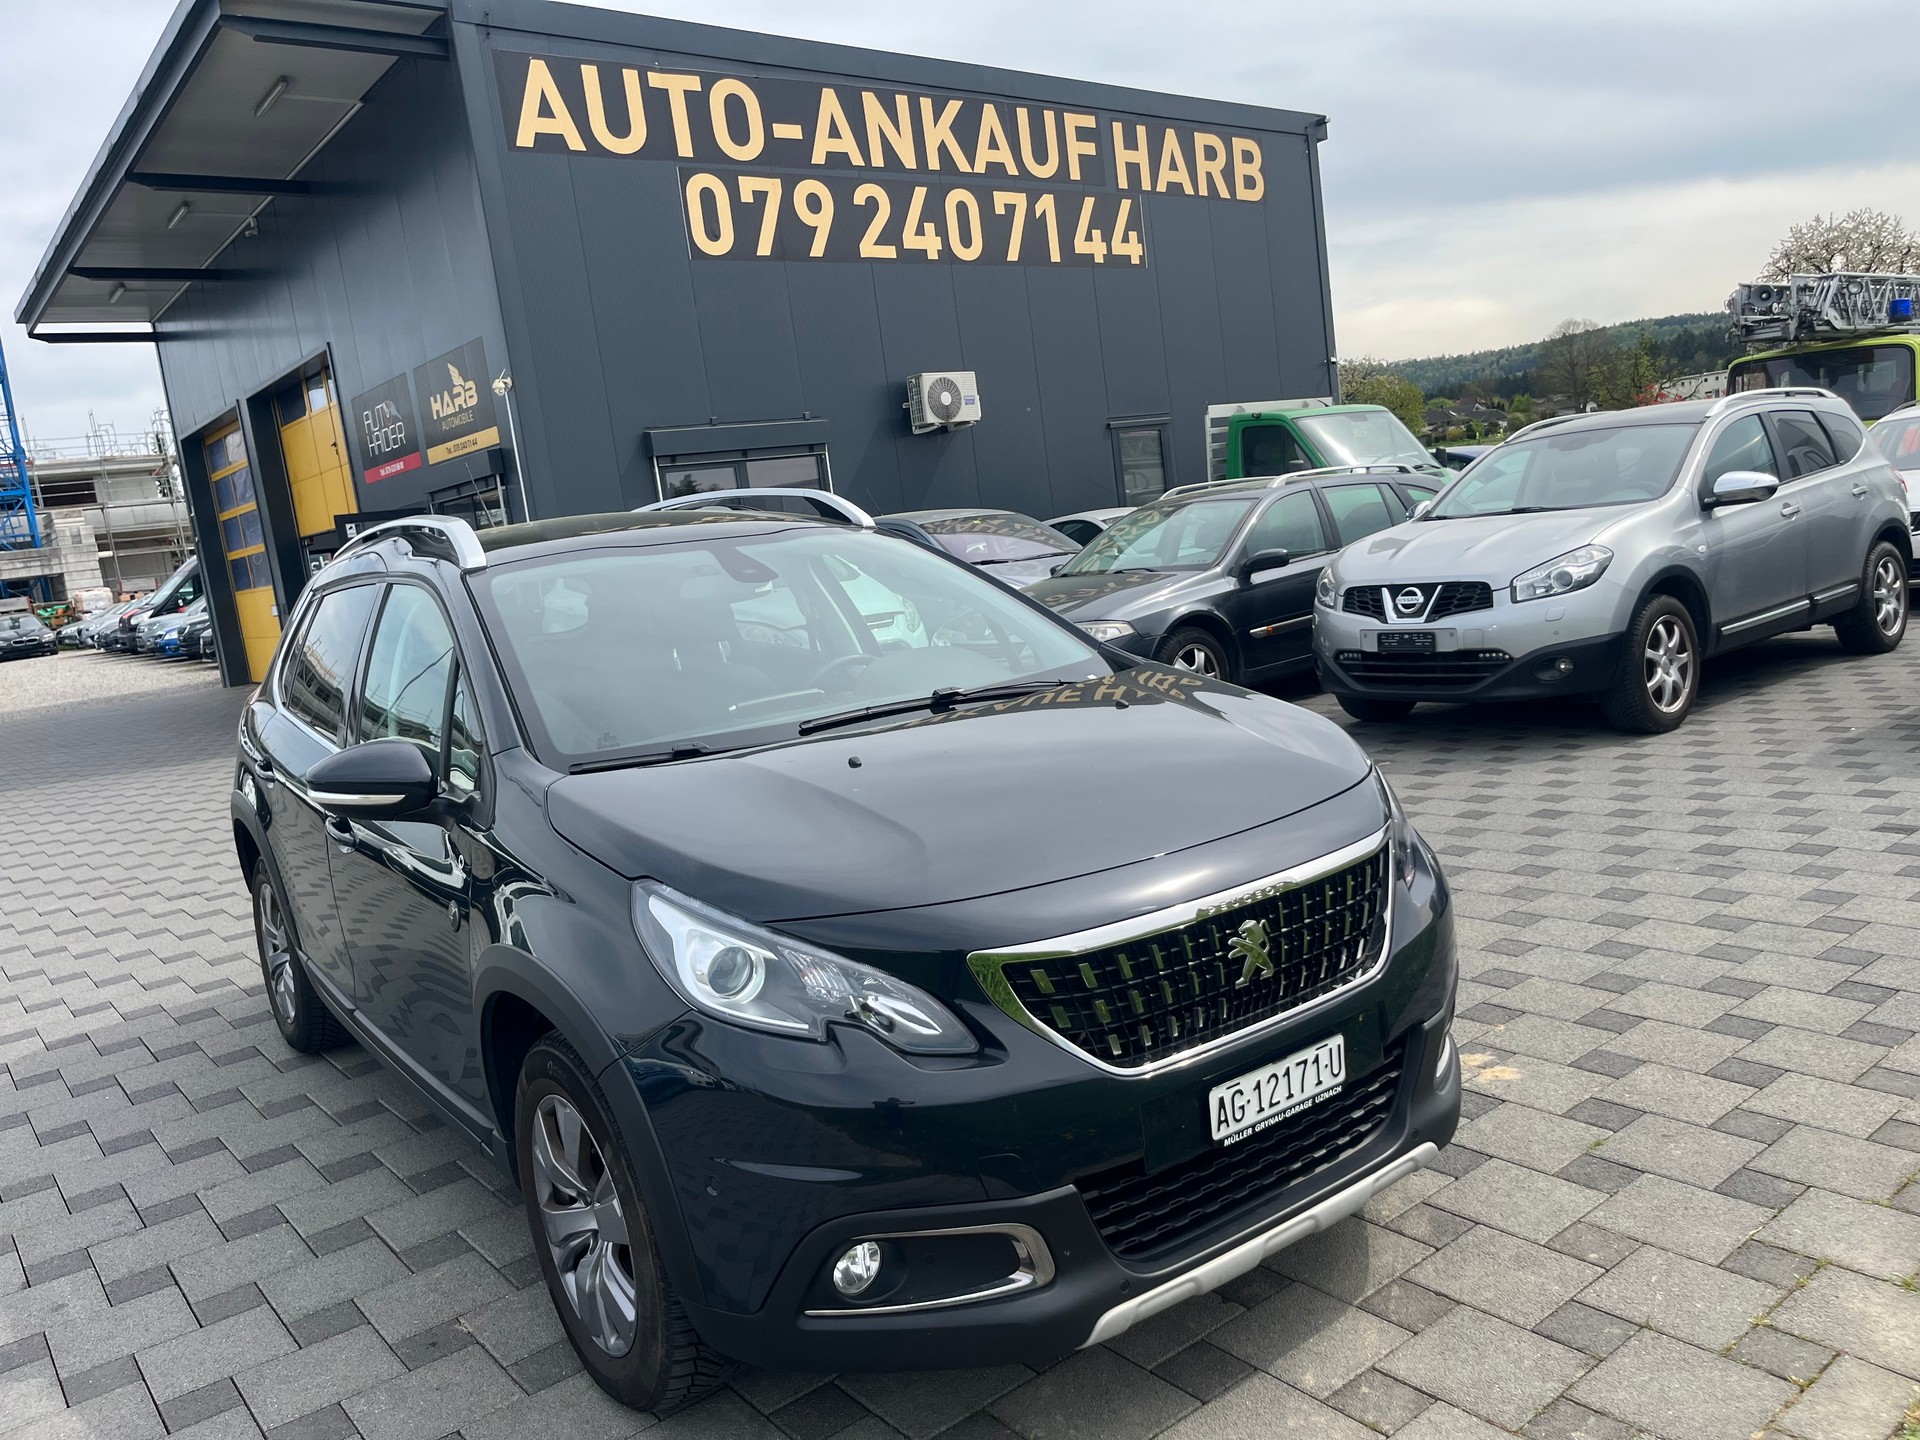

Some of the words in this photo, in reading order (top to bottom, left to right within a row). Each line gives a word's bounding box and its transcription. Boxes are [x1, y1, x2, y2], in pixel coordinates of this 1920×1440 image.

[515, 59, 1098, 182] AUTO-ANKAUF
[1112, 121, 1266, 202] HARB
[686, 172, 835, 257] 079
[853, 183, 984, 261] 240
[993, 191, 1062, 263] 71
[1073, 196, 1144, 265] 44
[430, 380, 478, 420] HARB
[1223, 1127, 1253, 1147] MÜLLER
[1254, 1098, 1313, 1132] GRYNAU-GARAGE
[1315, 1085, 1342, 1103] UZNACH
